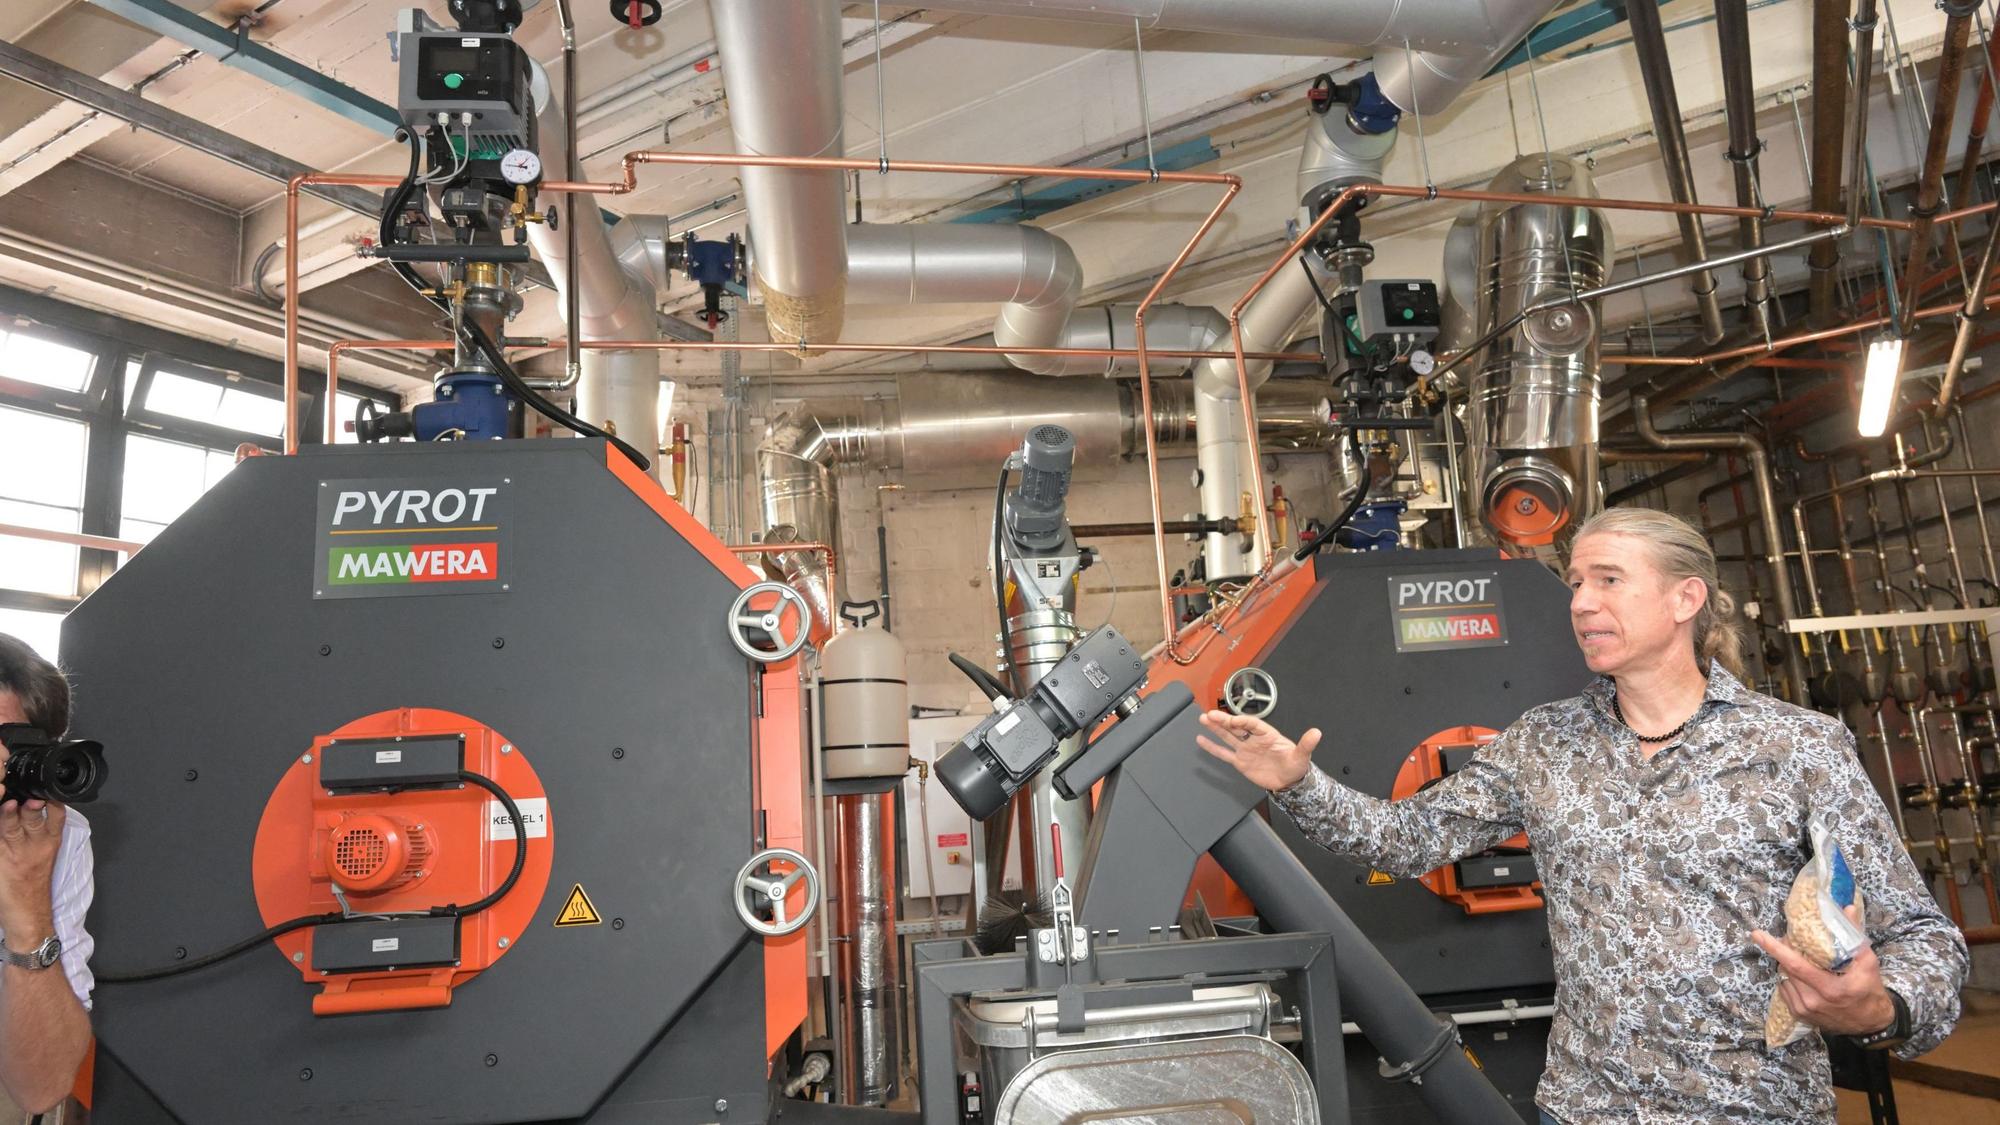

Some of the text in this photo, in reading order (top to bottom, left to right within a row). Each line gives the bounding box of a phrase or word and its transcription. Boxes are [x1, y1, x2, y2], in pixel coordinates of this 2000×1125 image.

[332, 488, 497, 525] PYROT
[338, 549, 488, 578] MAWERA
[1399, 579, 1491, 605] PYROT
[1408, 618, 1494, 639] MAWERA
[493, 814, 543, 824] KESEL 1
